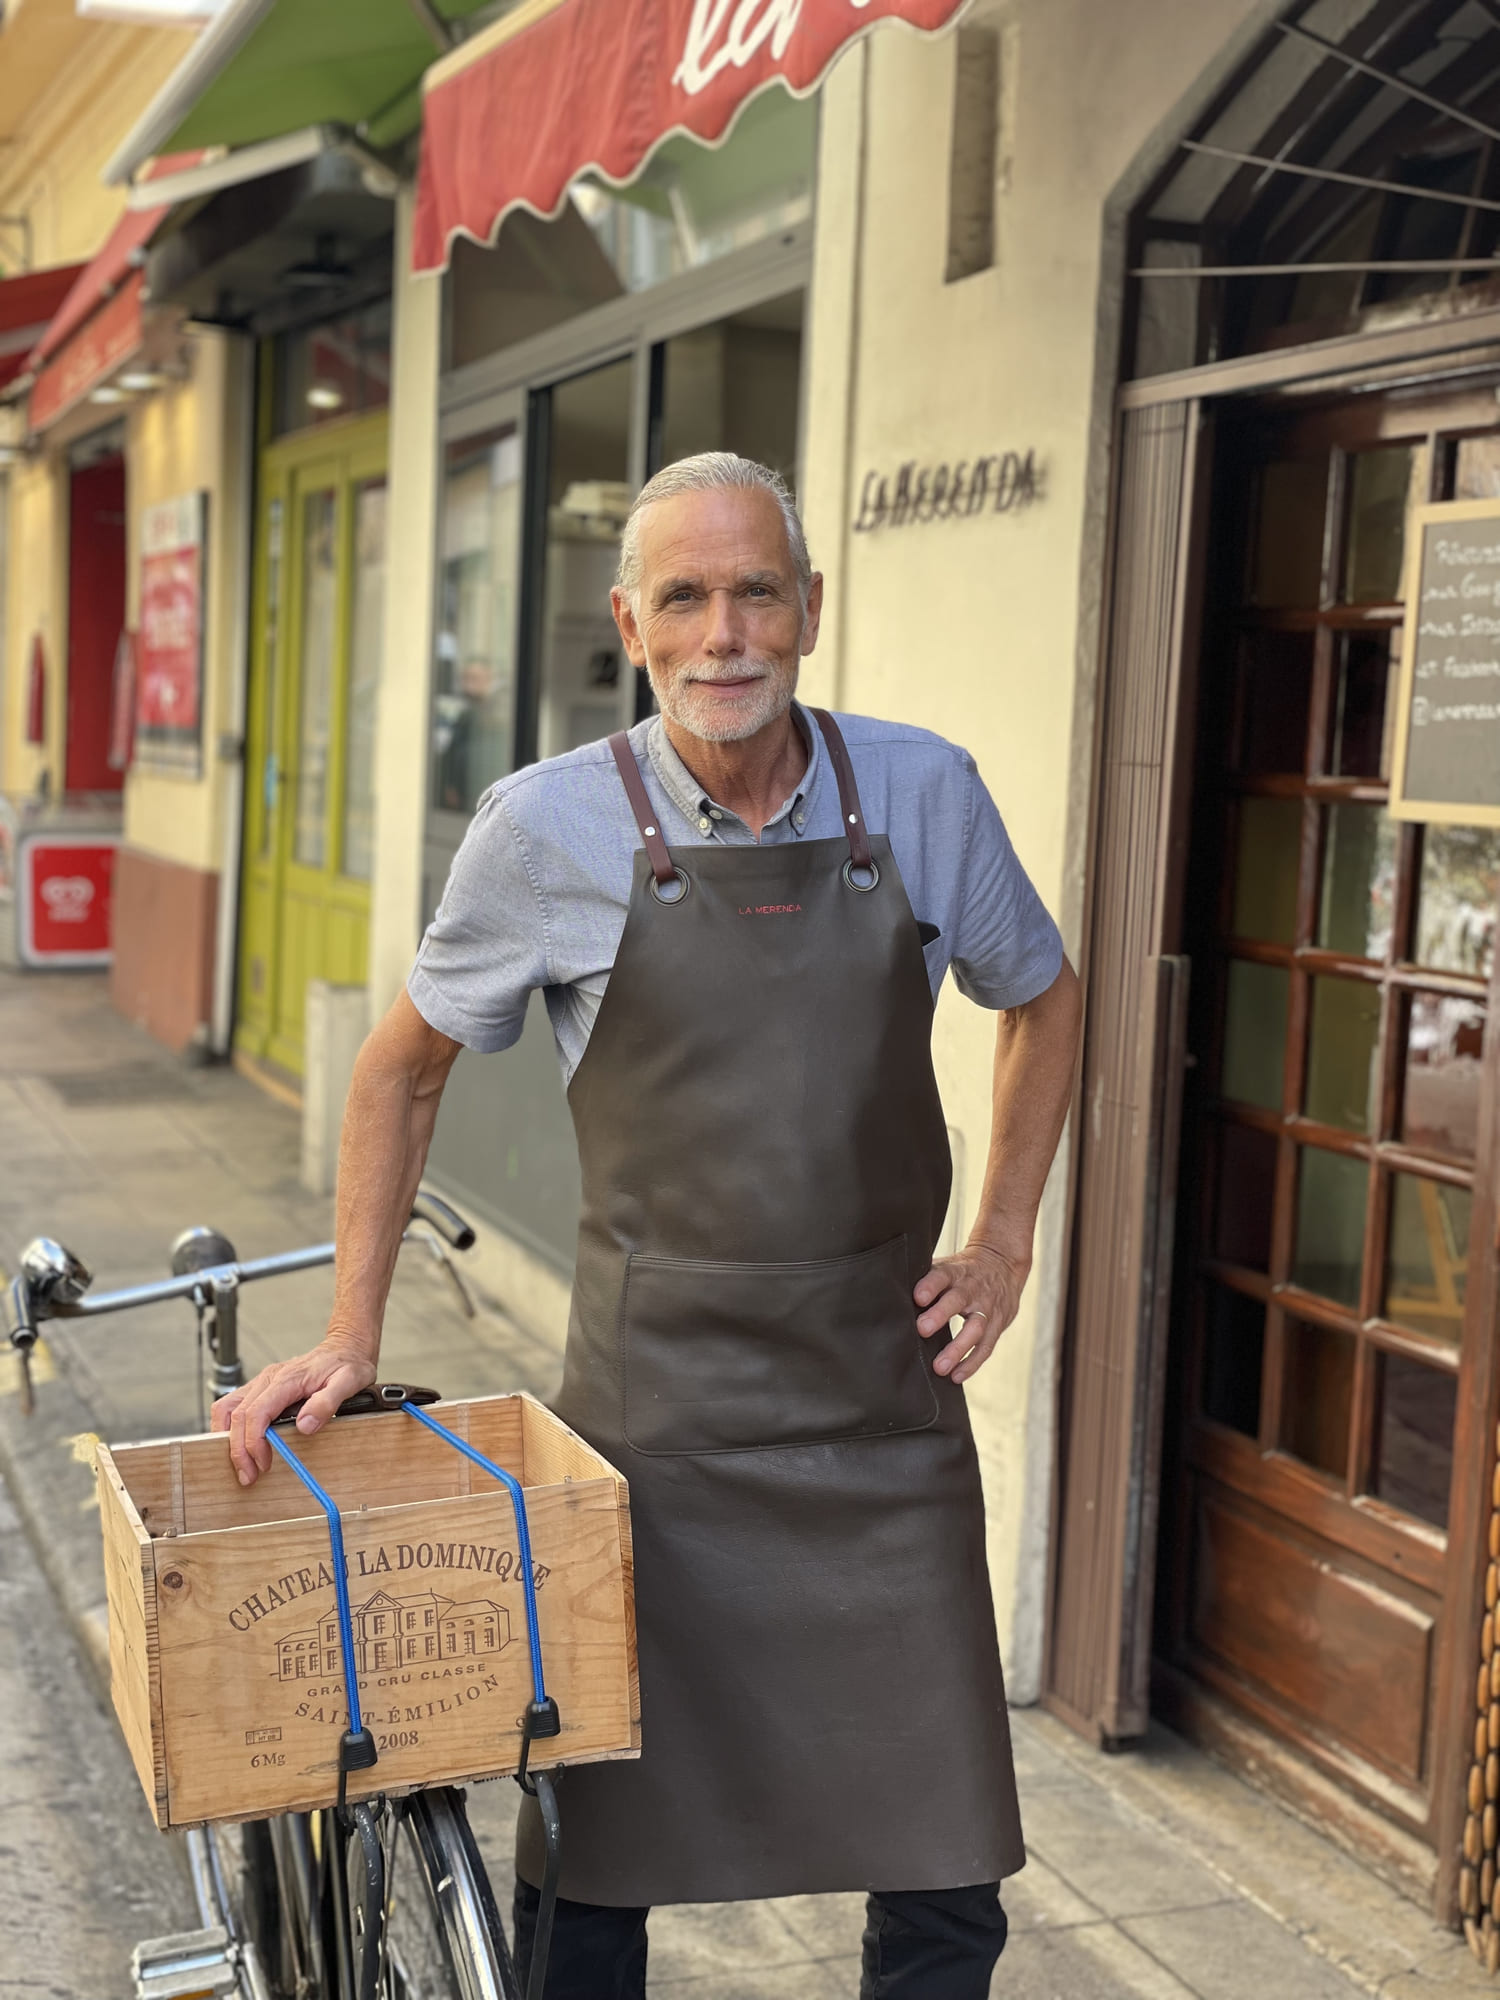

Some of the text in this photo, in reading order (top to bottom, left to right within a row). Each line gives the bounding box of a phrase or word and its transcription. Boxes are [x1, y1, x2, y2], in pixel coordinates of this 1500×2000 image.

[738, 904, 802, 915] LA MERENDA
[356, 1546, 393, 1577] LA
[396, 1542, 552, 1592] DOMINIQUE
[307, 1663, 487, 1697] GRAD CRU CLASSE
[378, 1730, 420, 1751] 2008
[250, 1752, 286, 1768] 6 Mg
